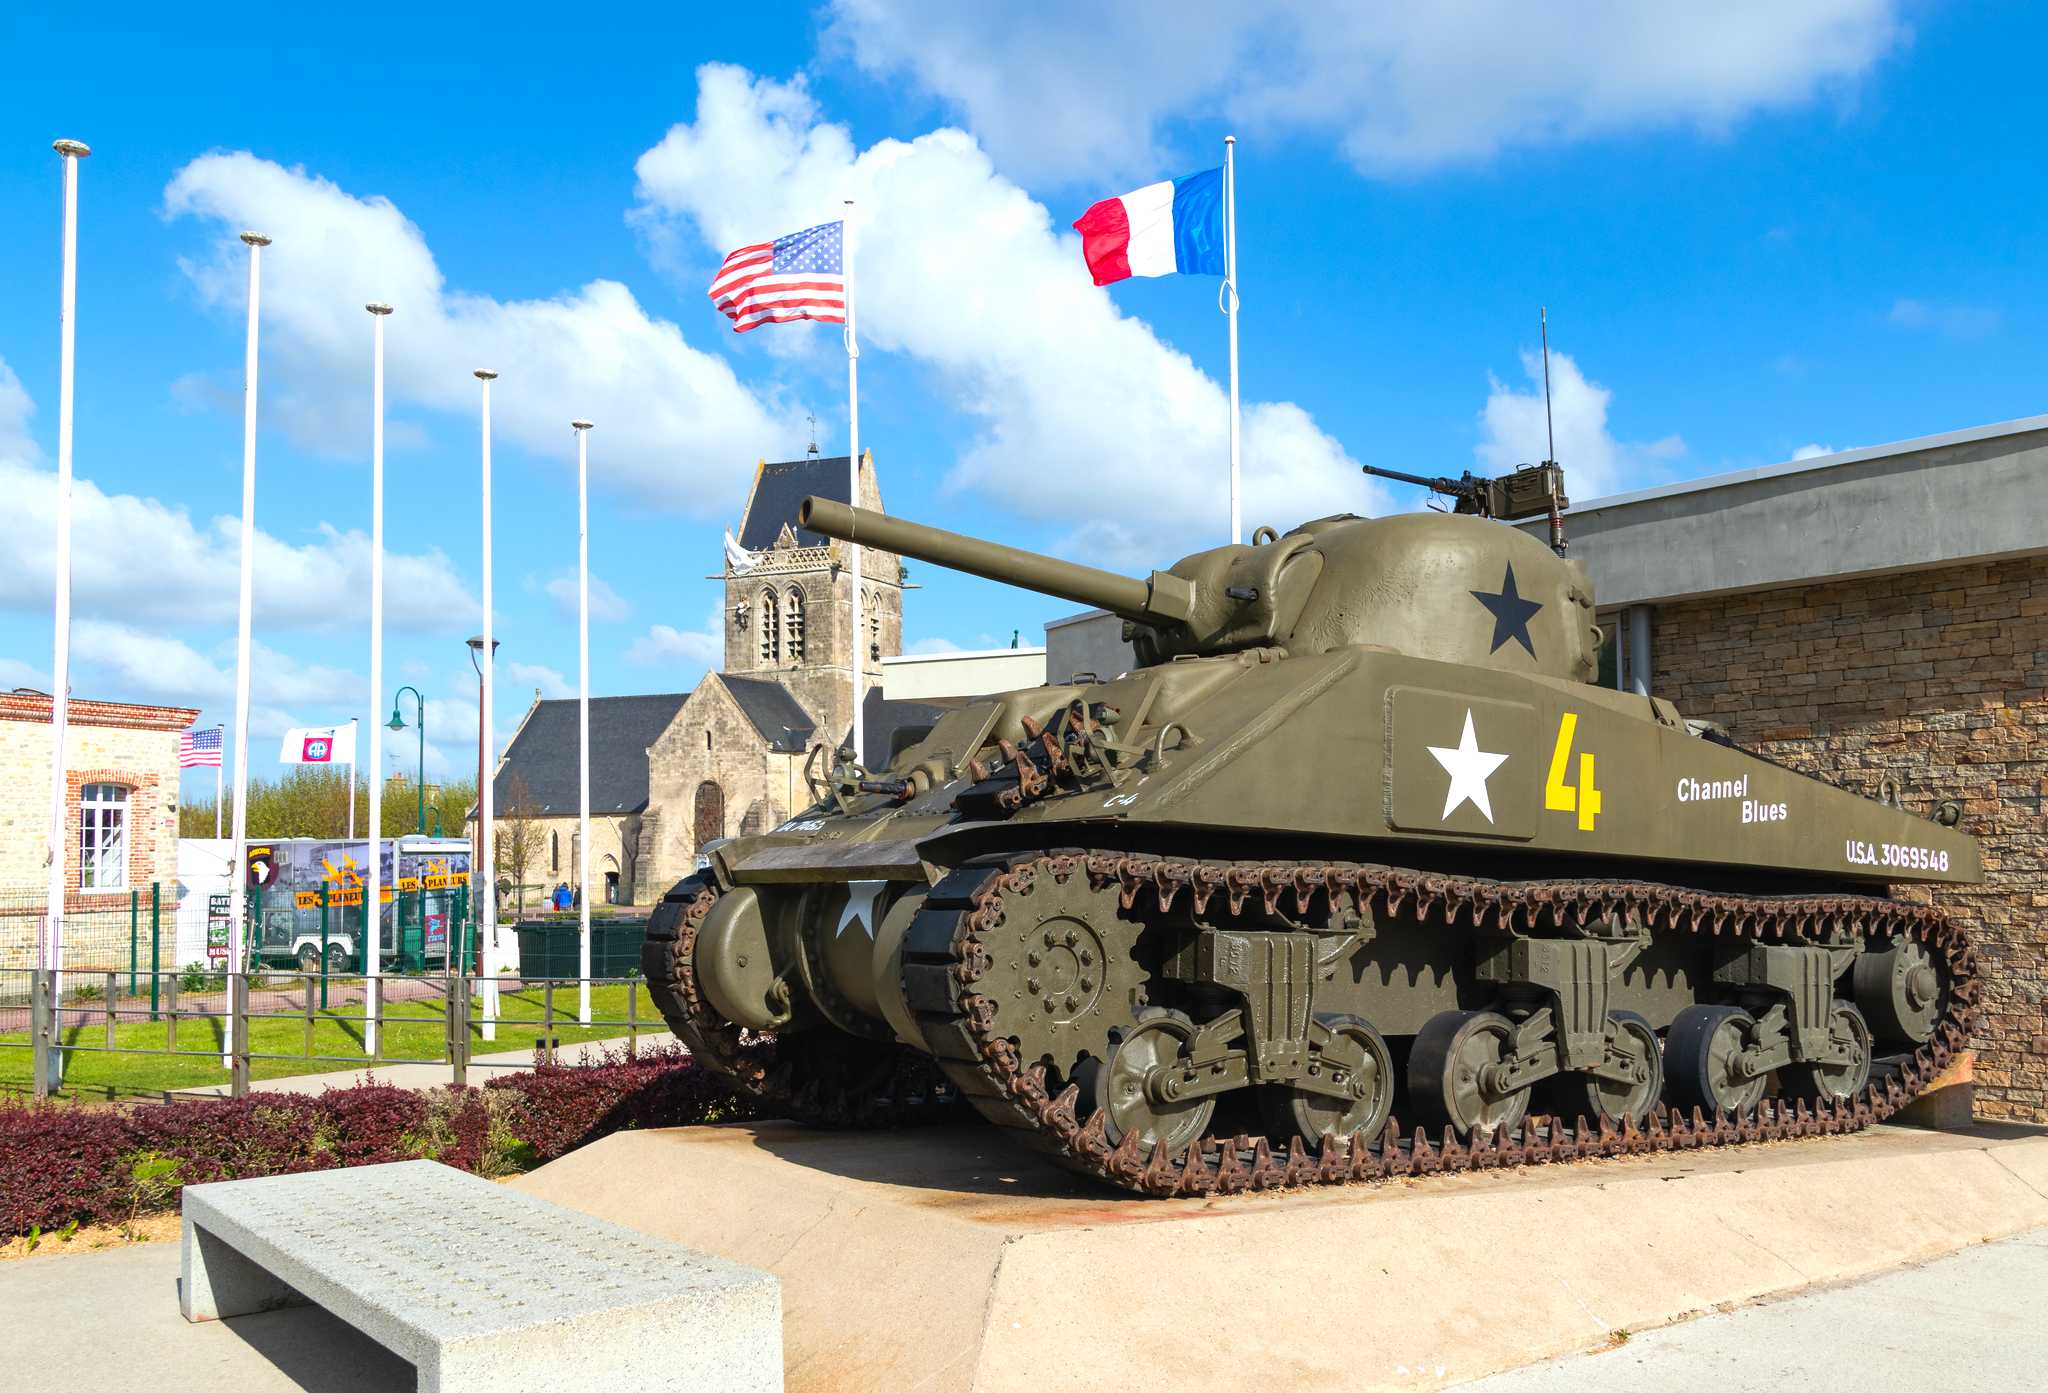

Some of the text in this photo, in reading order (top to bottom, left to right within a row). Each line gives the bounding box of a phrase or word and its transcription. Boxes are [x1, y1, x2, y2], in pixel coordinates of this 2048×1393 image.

[1545, 712, 1601, 831] 4
[1677, 774, 1748, 802] Channel
[1742, 799, 1787, 824] Blues
[1846, 840, 1949, 872] U.S.A. 3069548
[402, 880, 416, 890] LES
[428, 876, 467, 888] PLANURS
[298, 896, 314, 905] LES
